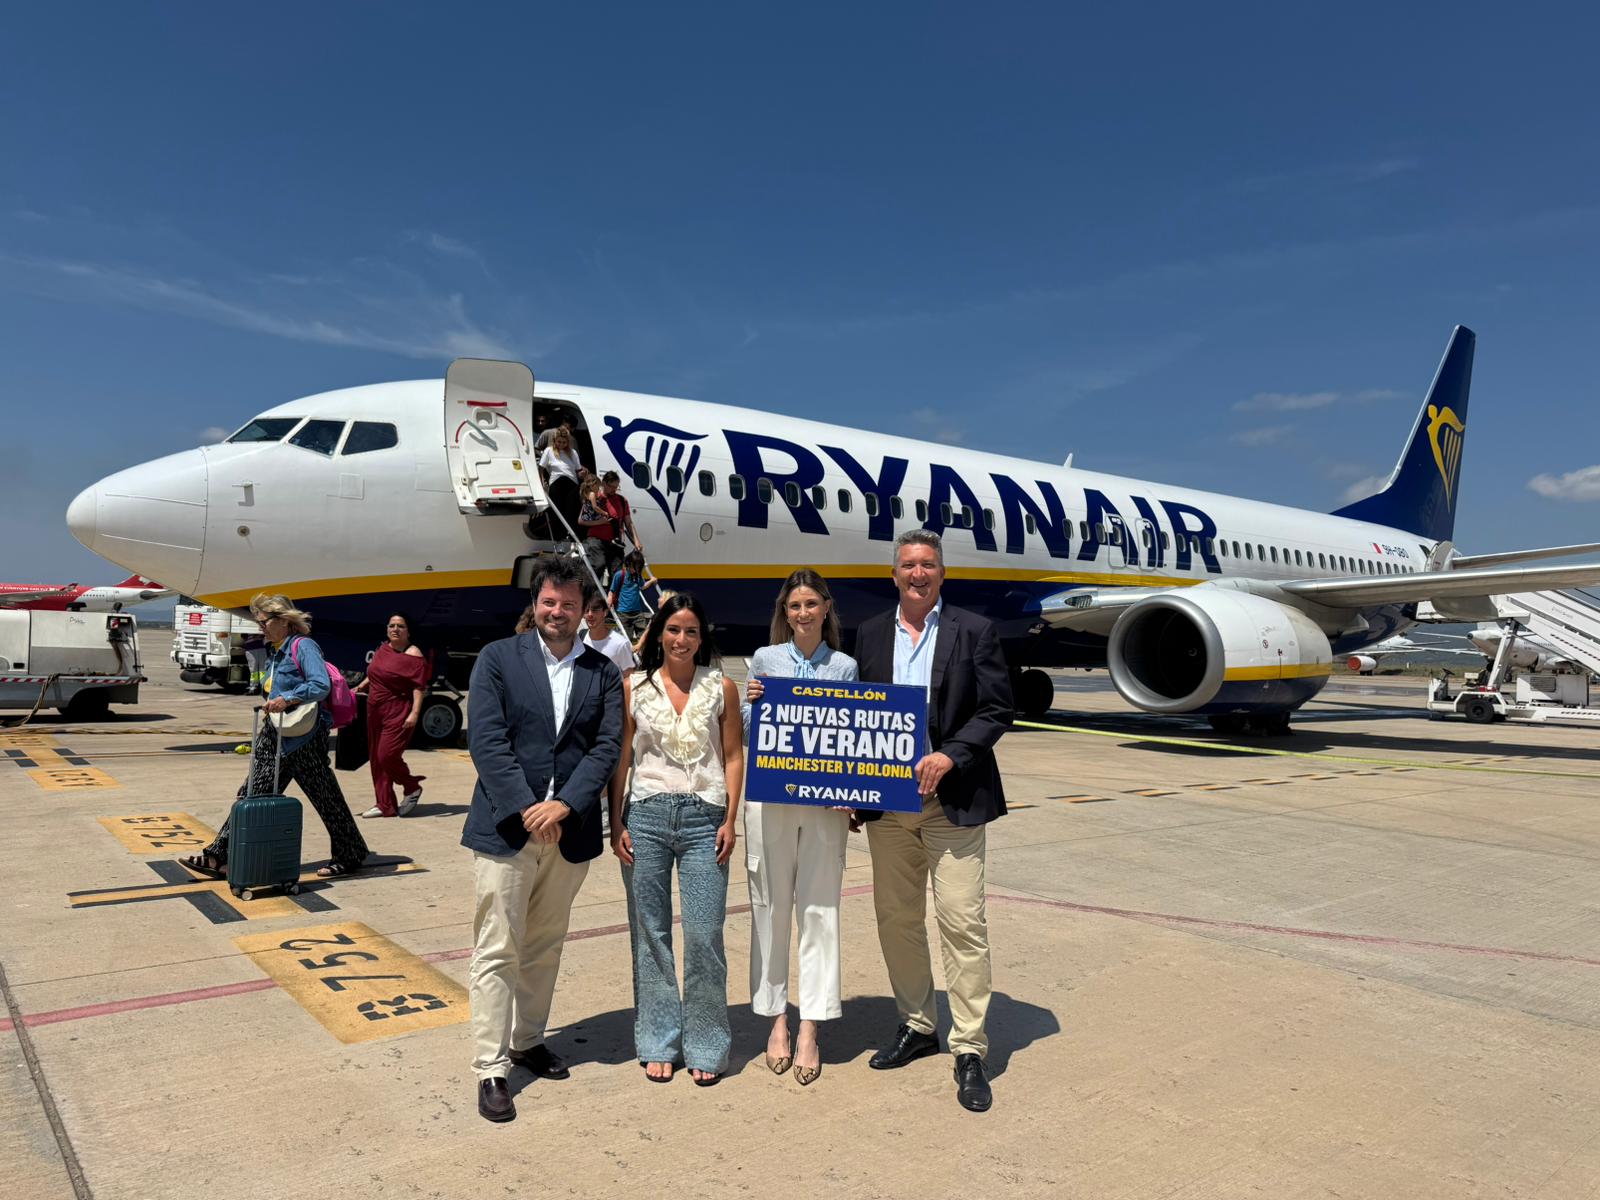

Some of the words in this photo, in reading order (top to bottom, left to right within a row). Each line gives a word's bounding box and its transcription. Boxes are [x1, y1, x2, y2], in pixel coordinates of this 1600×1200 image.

[722, 429, 1223, 574] RYANAIR
[792, 686, 887, 701] CASTELLÓN
[759, 703, 772, 722] 2
[776, 704, 850, 727] NUEVAS
[854, 709, 916, 732] RUTAS
[757, 723, 795, 753] DE
[801, 726, 915, 762] VERANO
[756, 755, 843, 774] MANCHESTER
[845, 761, 855, 775] Y
[857, 763, 913, 780] BOLONIA
[798, 785, 882, 804] RYANAIR
